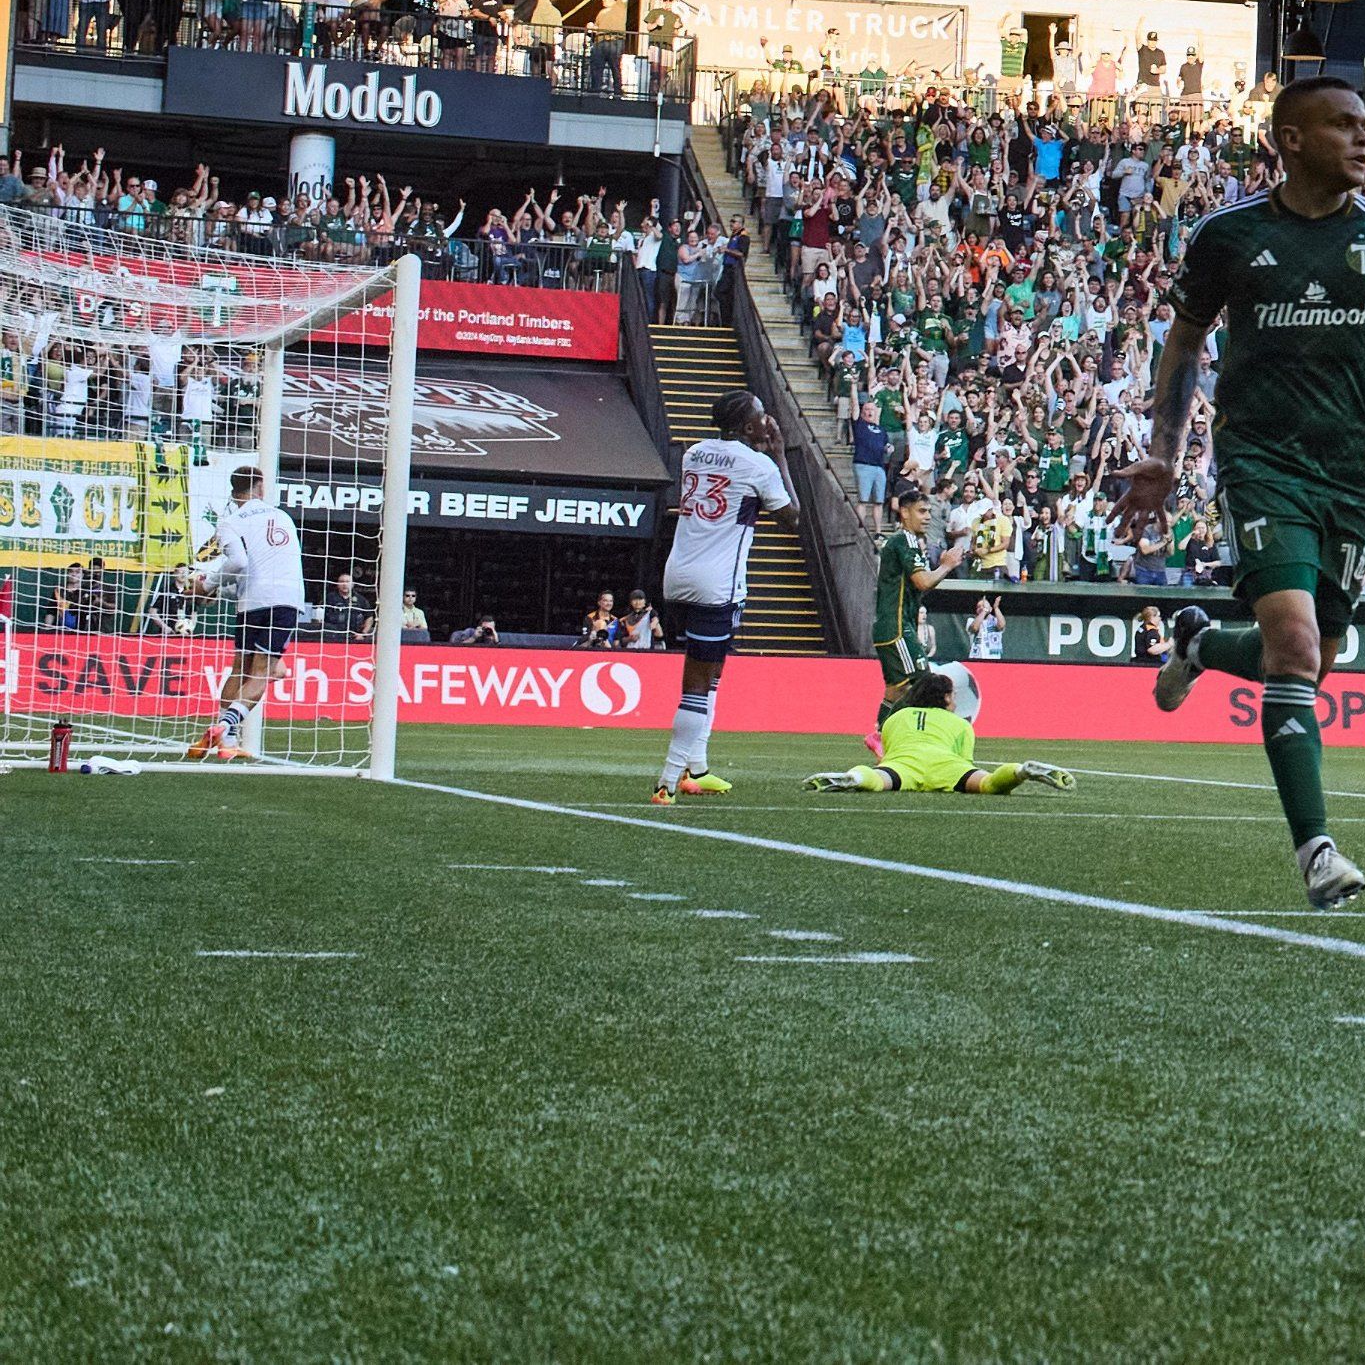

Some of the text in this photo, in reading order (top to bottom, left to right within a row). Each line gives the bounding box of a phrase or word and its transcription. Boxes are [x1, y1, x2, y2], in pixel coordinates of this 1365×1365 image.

[845, 11, 951, 41] TRUCK
[283, 61, 443, 129] Modelo
[433, 310, 455, 323] the
[458, 310, 515, 327] Portland
[518, 314, 574, 331] Timbers.
[690, 450, 736, 469] BROWN
[275, 482, 646, 528] TRAPPR BEEF JERKY
[680, 470, 732, 524] 23
[266, 518, 290, 547] 6
[37, 654, 188, 697] SAVE
